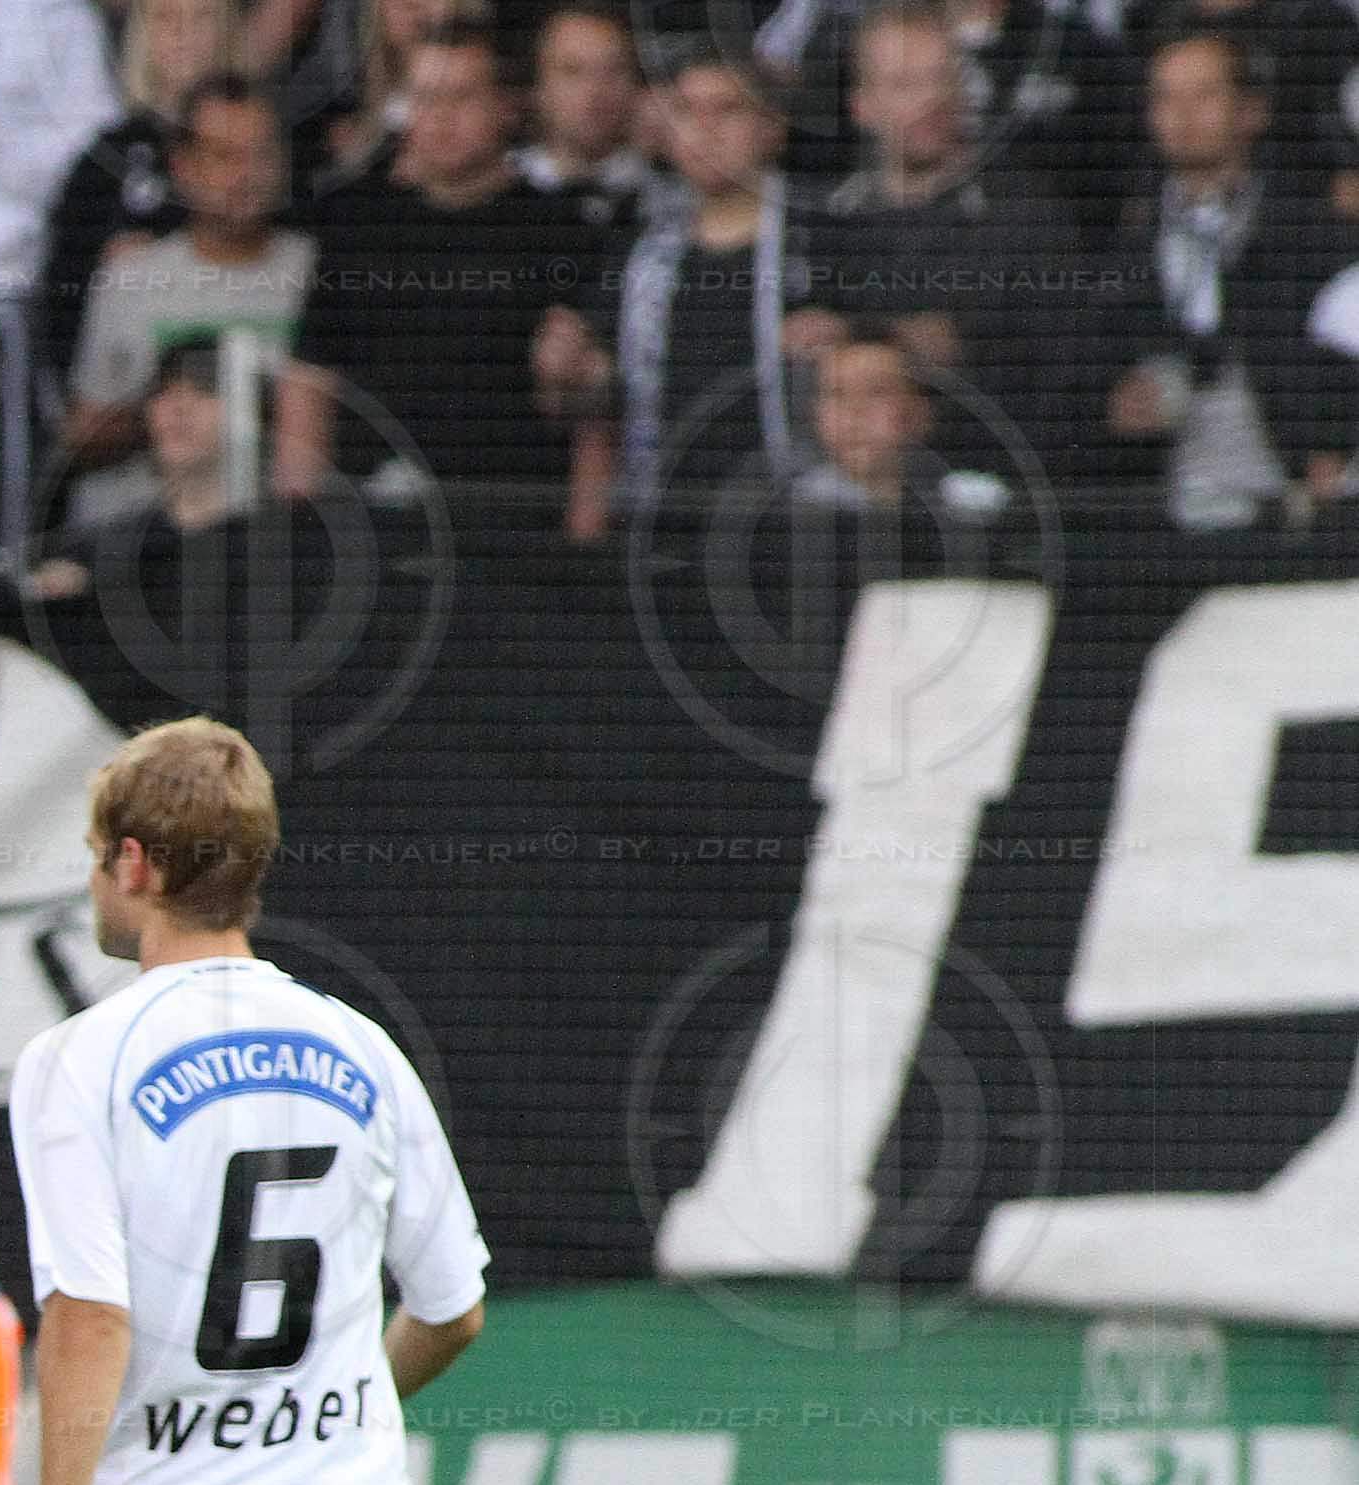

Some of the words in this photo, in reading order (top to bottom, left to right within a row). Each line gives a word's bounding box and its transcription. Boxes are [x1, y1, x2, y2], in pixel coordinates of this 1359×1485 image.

[135, 1042, 376, 1123] PUNTIGAMER
[196, 1146, 338, 1371] 6
[145, 1377, 372, 1453] weber
